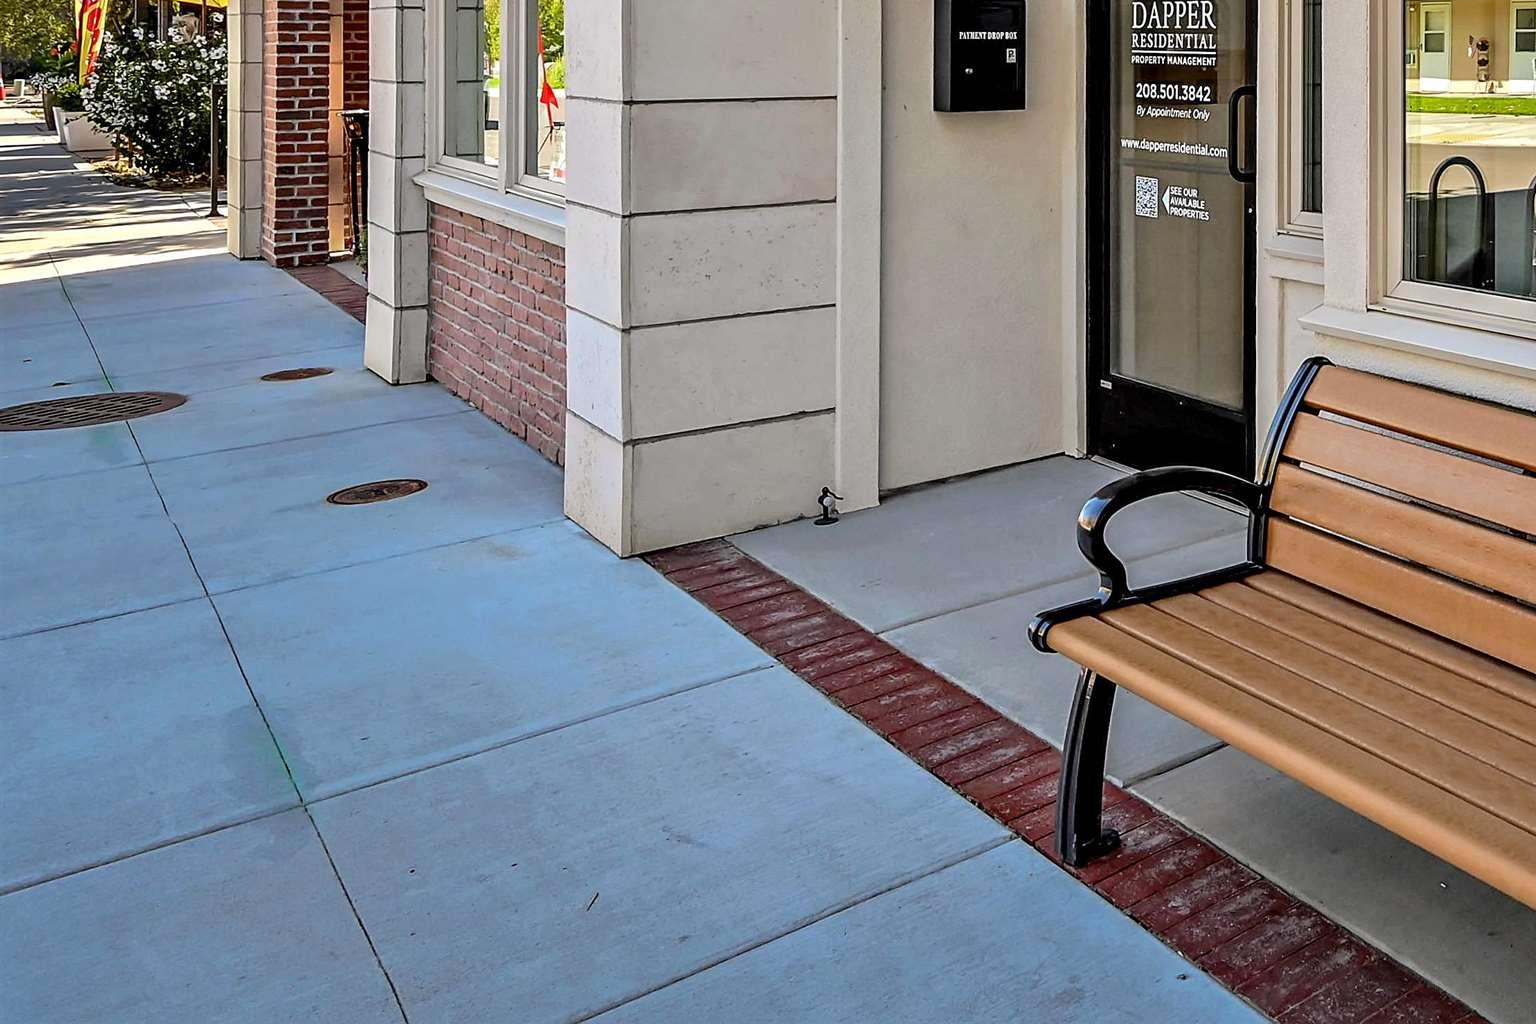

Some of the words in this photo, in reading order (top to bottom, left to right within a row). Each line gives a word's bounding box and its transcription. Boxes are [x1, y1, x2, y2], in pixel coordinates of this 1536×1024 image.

[1131, 0, 1217, 29] DAPPER
[959, 31, 987, 40] PAYMENT
[987, 31, 1004, 40] DROP
[1005, 31, 1018, 40] BOX
[1131, 33, 1217, 50] RESIDENTIAL
[1131, 55, 1166, 65] PROPERTY
[1167, 55, 1217, 66] MANAGEMENT
[1135, 83, 1211, 102] 208.501.3842
[1136, 105, 1146, 117] By
[1147, 106, 1192, 119] Appointment
[1192, 108, 1211, 122] Only
[1120, 137, 1228, 158] www.dapperresidential.com
[1170, 186, 1182, 196] SEE
[1183, 188, 1198, 198] OUR
[1170, 196, 1205, 210] AVAILABLE
[1170, 207, 1210, 220] PROPERTIES
